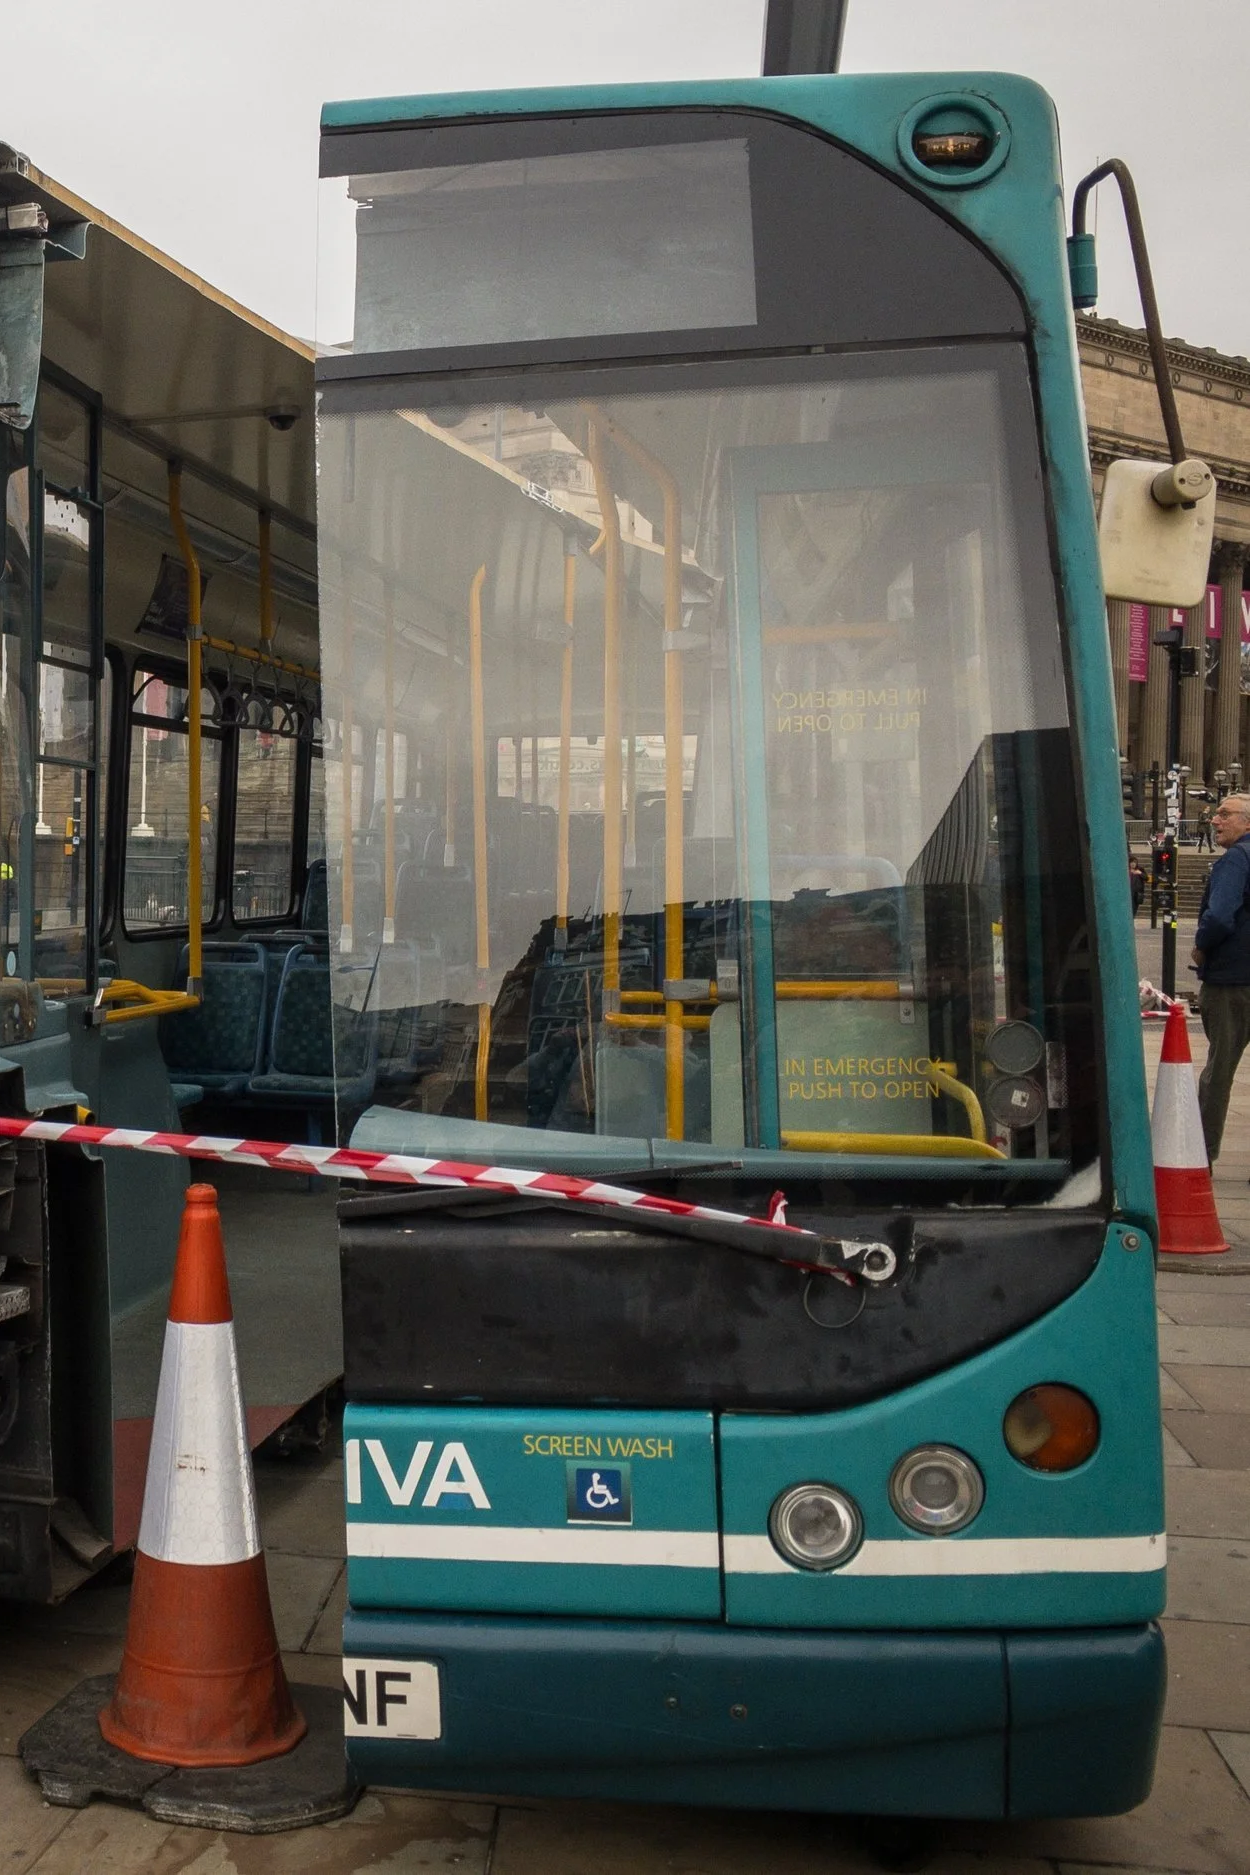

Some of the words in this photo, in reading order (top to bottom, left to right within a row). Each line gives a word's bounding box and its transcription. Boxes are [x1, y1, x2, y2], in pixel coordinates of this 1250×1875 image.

[785, 1059, 806, 1077] IN
[813, 1056, 941, 1077] EMERGENCY
[788, 1081, 842, 1100] PUSH
[850, 1081, 877, 1099] TO
[884, 1081, 940, 1099] OPEN
[523, 1435, 601, 1458] SCREEN
[607, 1437, 674, 1459] WASH
[346, 1438, 491, 1510] IVA
